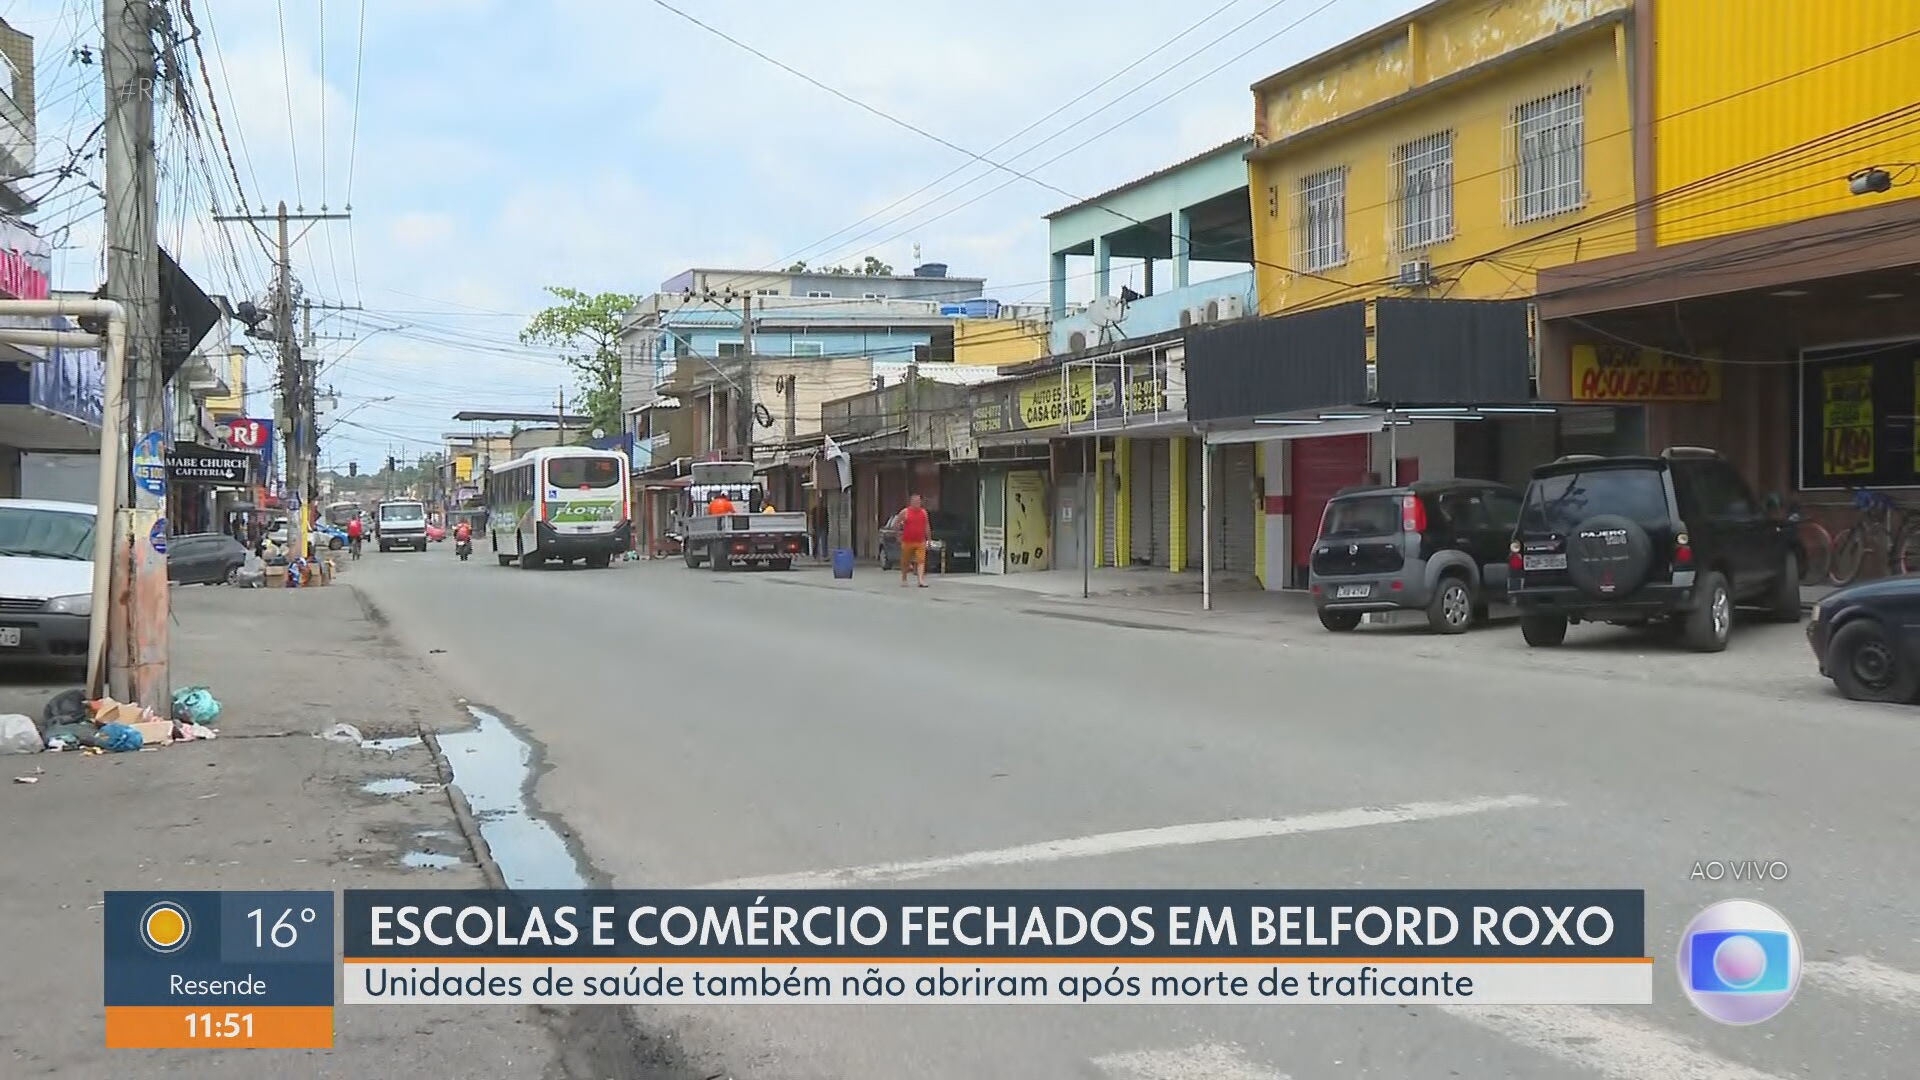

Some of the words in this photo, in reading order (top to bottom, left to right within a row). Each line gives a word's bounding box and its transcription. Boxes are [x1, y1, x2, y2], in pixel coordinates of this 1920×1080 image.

[1032, 388, 1051, 405] AUTO
[1052, 383, 1080, 401] ESLA
[1026, 404, 1049, 423] CASA
[199, 458, 247, 469] CHURCH
[175, 467, 224, 477] CAFETERIA
[555, 506, 615, 515] FLORES
[1580, 529, 1627, 538] PAJERO
